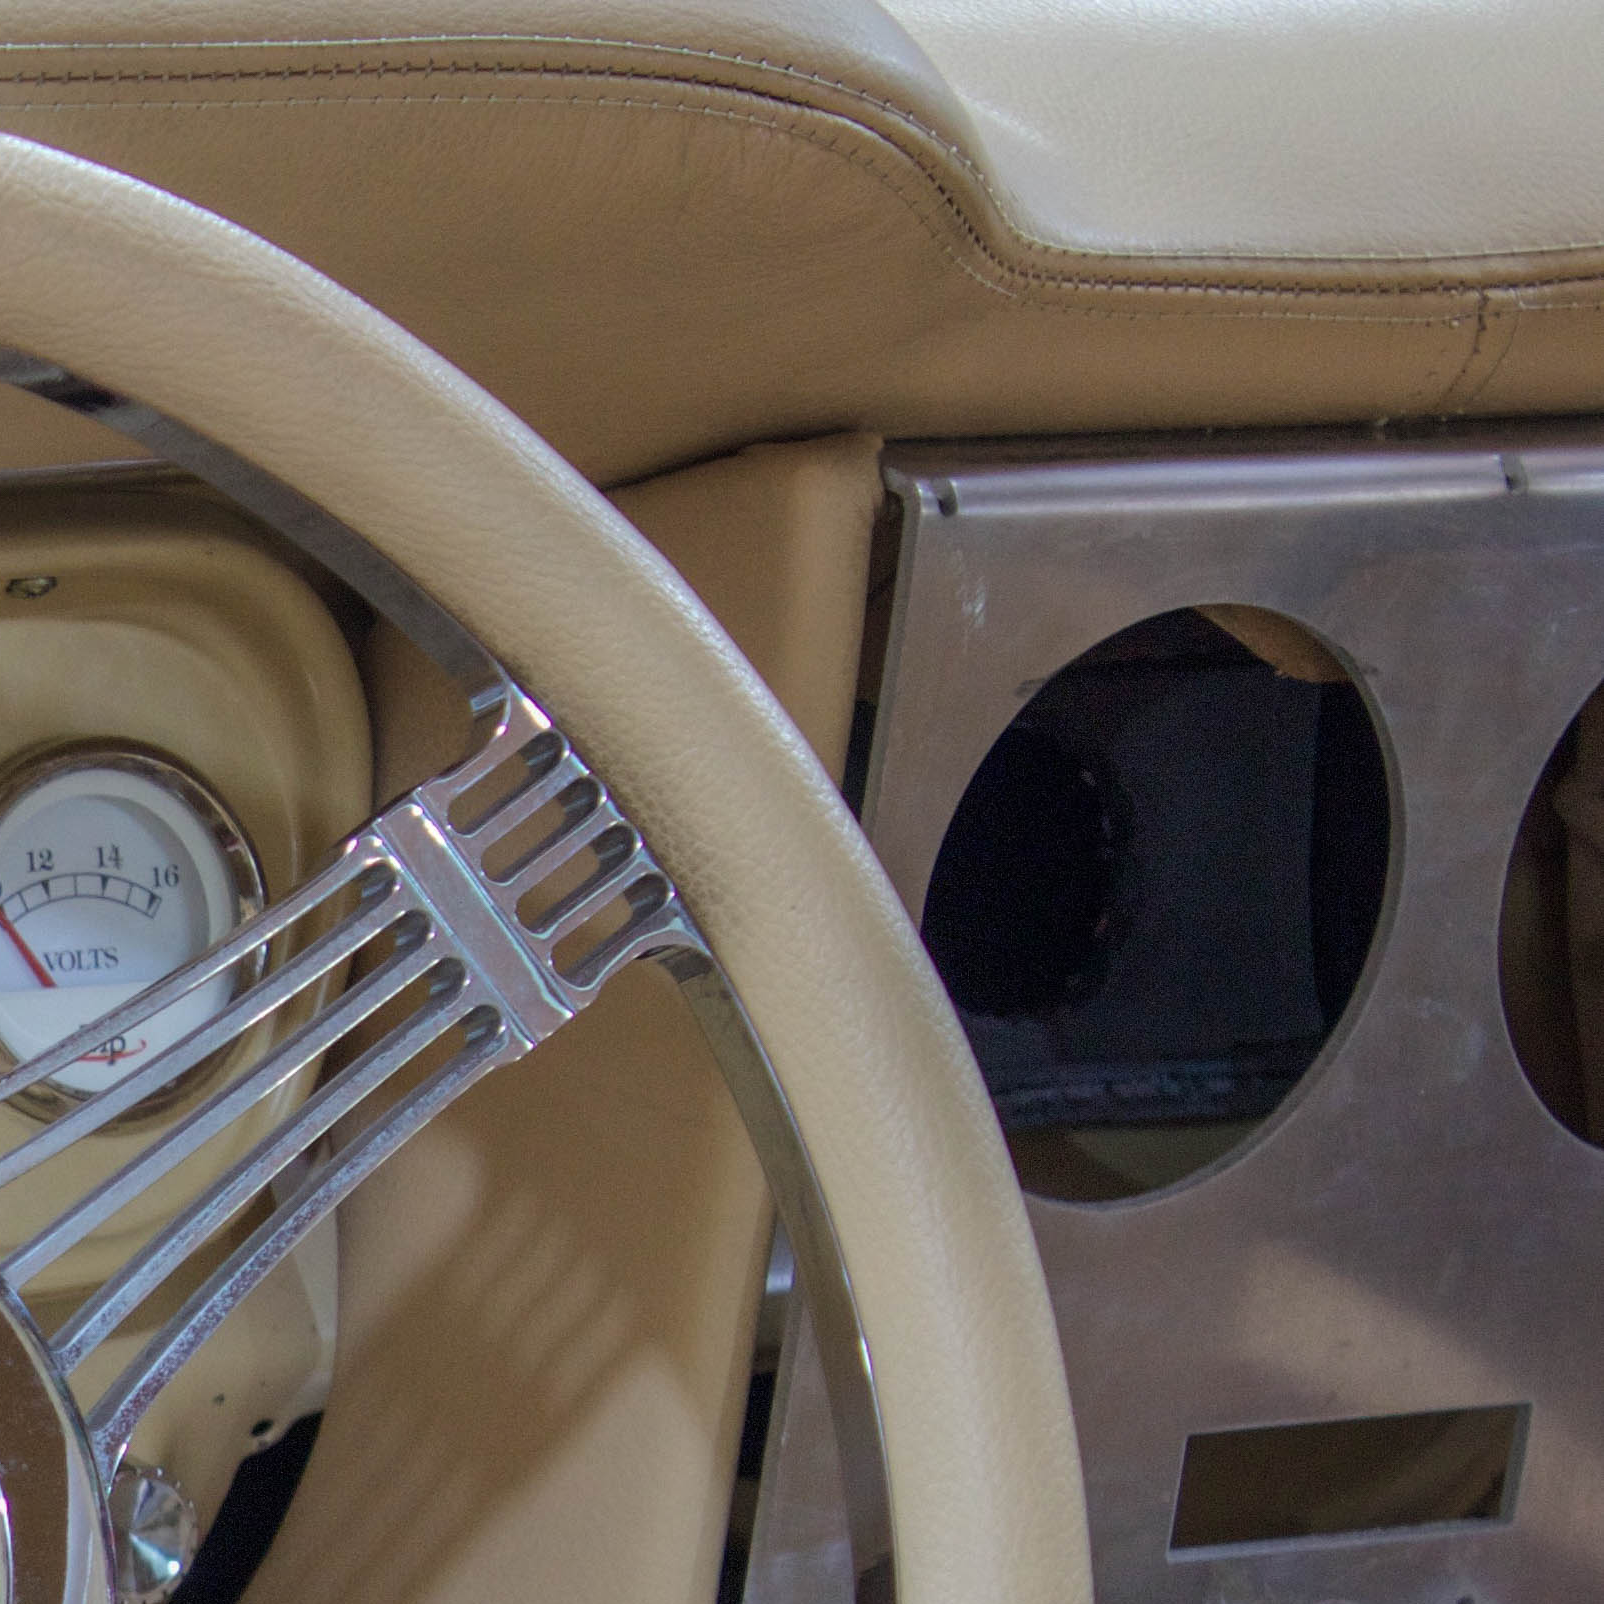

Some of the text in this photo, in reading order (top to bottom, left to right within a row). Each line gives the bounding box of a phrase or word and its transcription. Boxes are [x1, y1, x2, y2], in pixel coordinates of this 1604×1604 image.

[25, 848, 55, 873] 12
[95, 844, 124, 871] 14
[151, 864, 181, 889] 16
[42, 946, 120, 973] VOLTS
